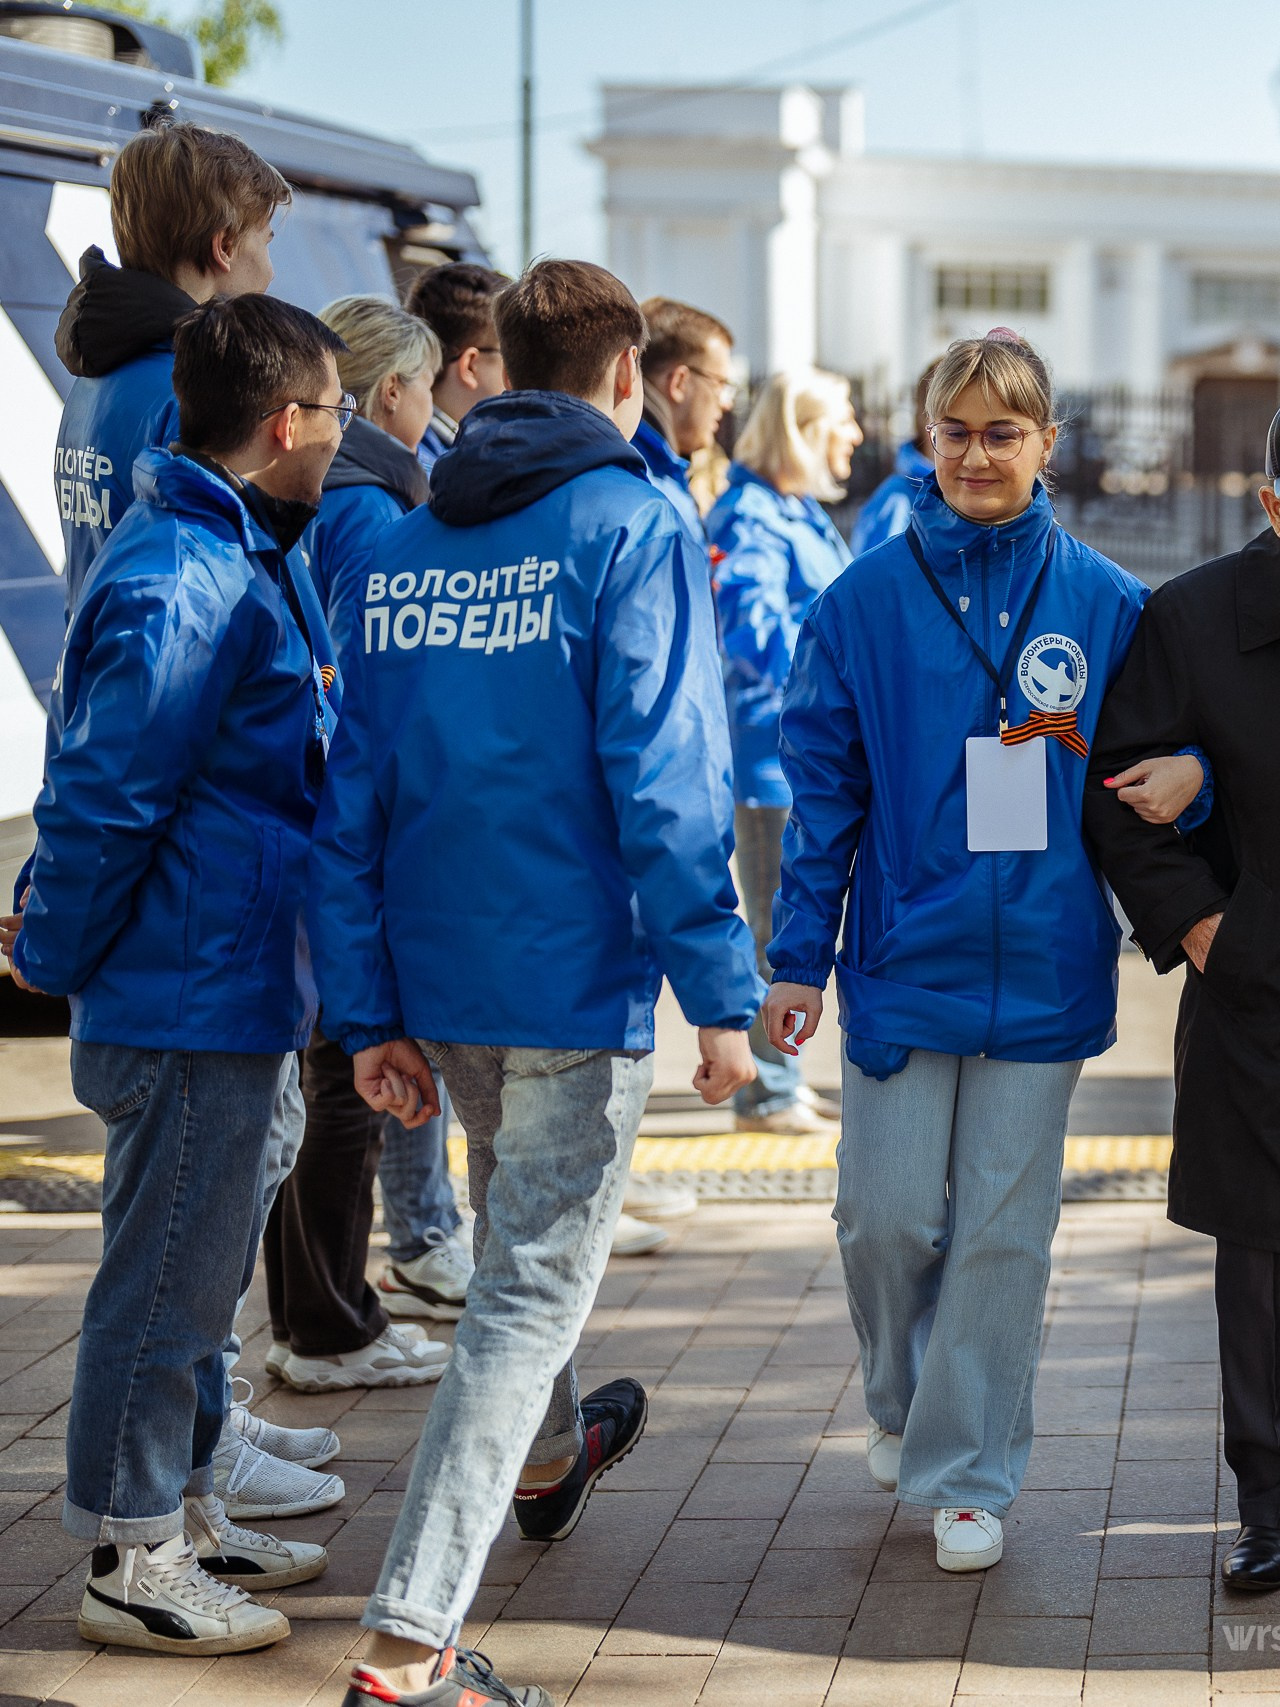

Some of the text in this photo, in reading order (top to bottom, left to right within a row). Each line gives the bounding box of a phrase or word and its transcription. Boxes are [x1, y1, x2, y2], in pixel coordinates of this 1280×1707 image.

[366, 556, 560, 602] ВОЛОНТЁР
[365, 594, 554, 655] ПОБЕДЫ
[1021, 636, 1086, 680] ВОЛОНТЁРЫ ПОБЕДЫ
